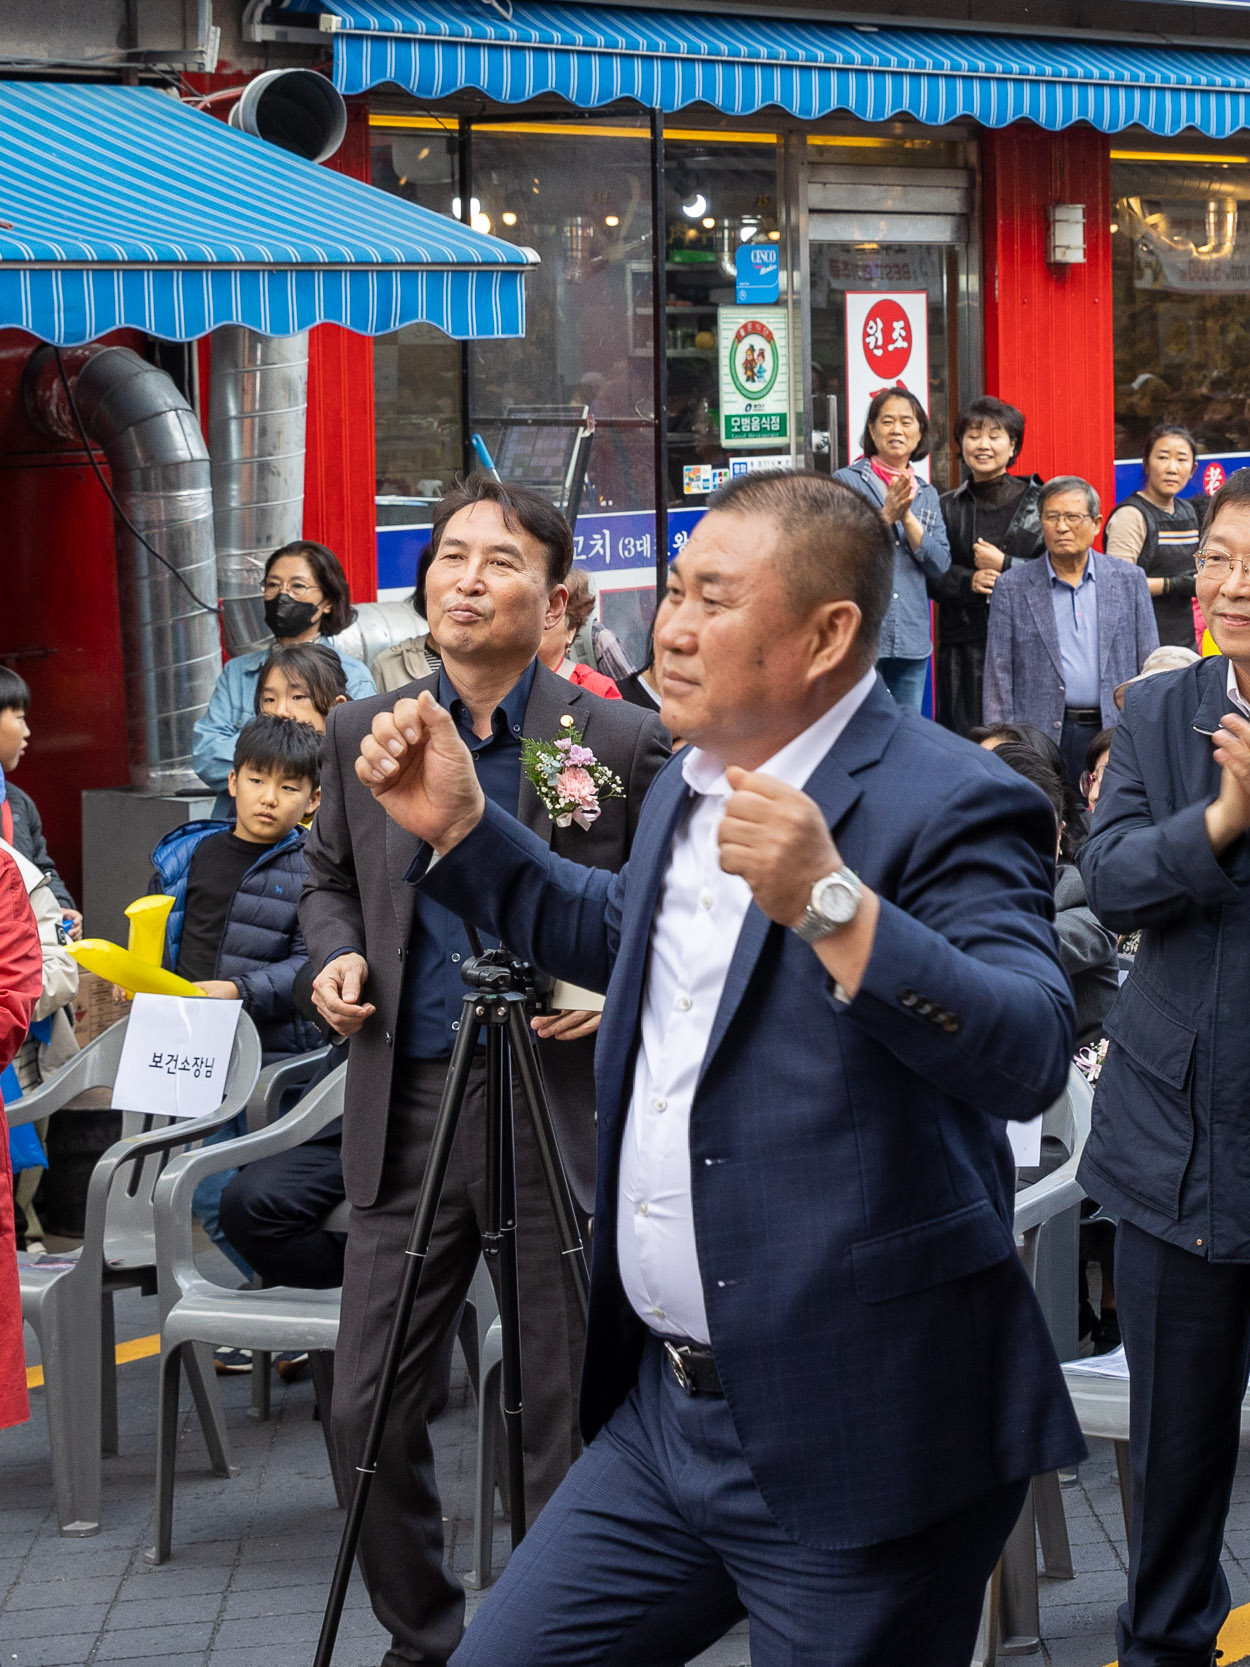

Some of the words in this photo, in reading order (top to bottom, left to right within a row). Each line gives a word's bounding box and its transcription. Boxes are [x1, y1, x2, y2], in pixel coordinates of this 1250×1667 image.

[750, 249, 777, 264] CESCO
[865, 317, 909, 357] 원조
[730, 415, 781, 433] 모범음식점
[149, 1052, 215, 1078] 보건소장님
